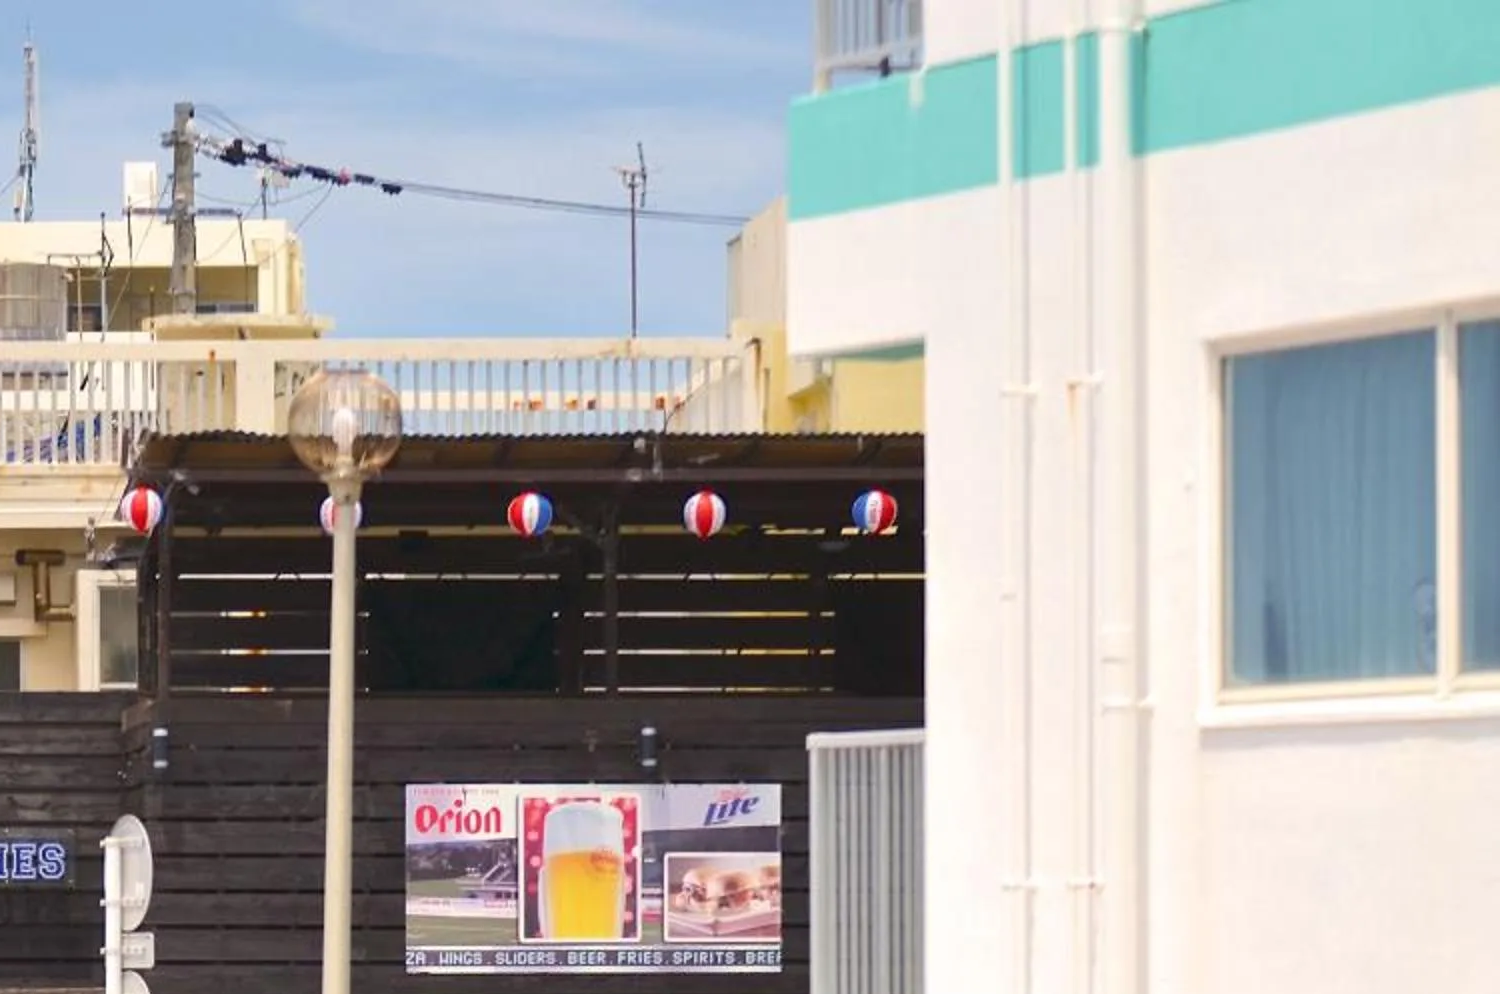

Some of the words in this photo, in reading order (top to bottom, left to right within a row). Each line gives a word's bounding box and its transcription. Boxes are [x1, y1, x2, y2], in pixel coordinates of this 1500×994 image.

[414, 800, 503, 834] Orion
[439, 951, 483, 966] WINGS
[495, 951, 556, 966] SLIDERS
[567, 951, 607, 966] BEER
[617, 951, 663, 966] FRIES
[672, 951, 736, 966] SPIRITS
